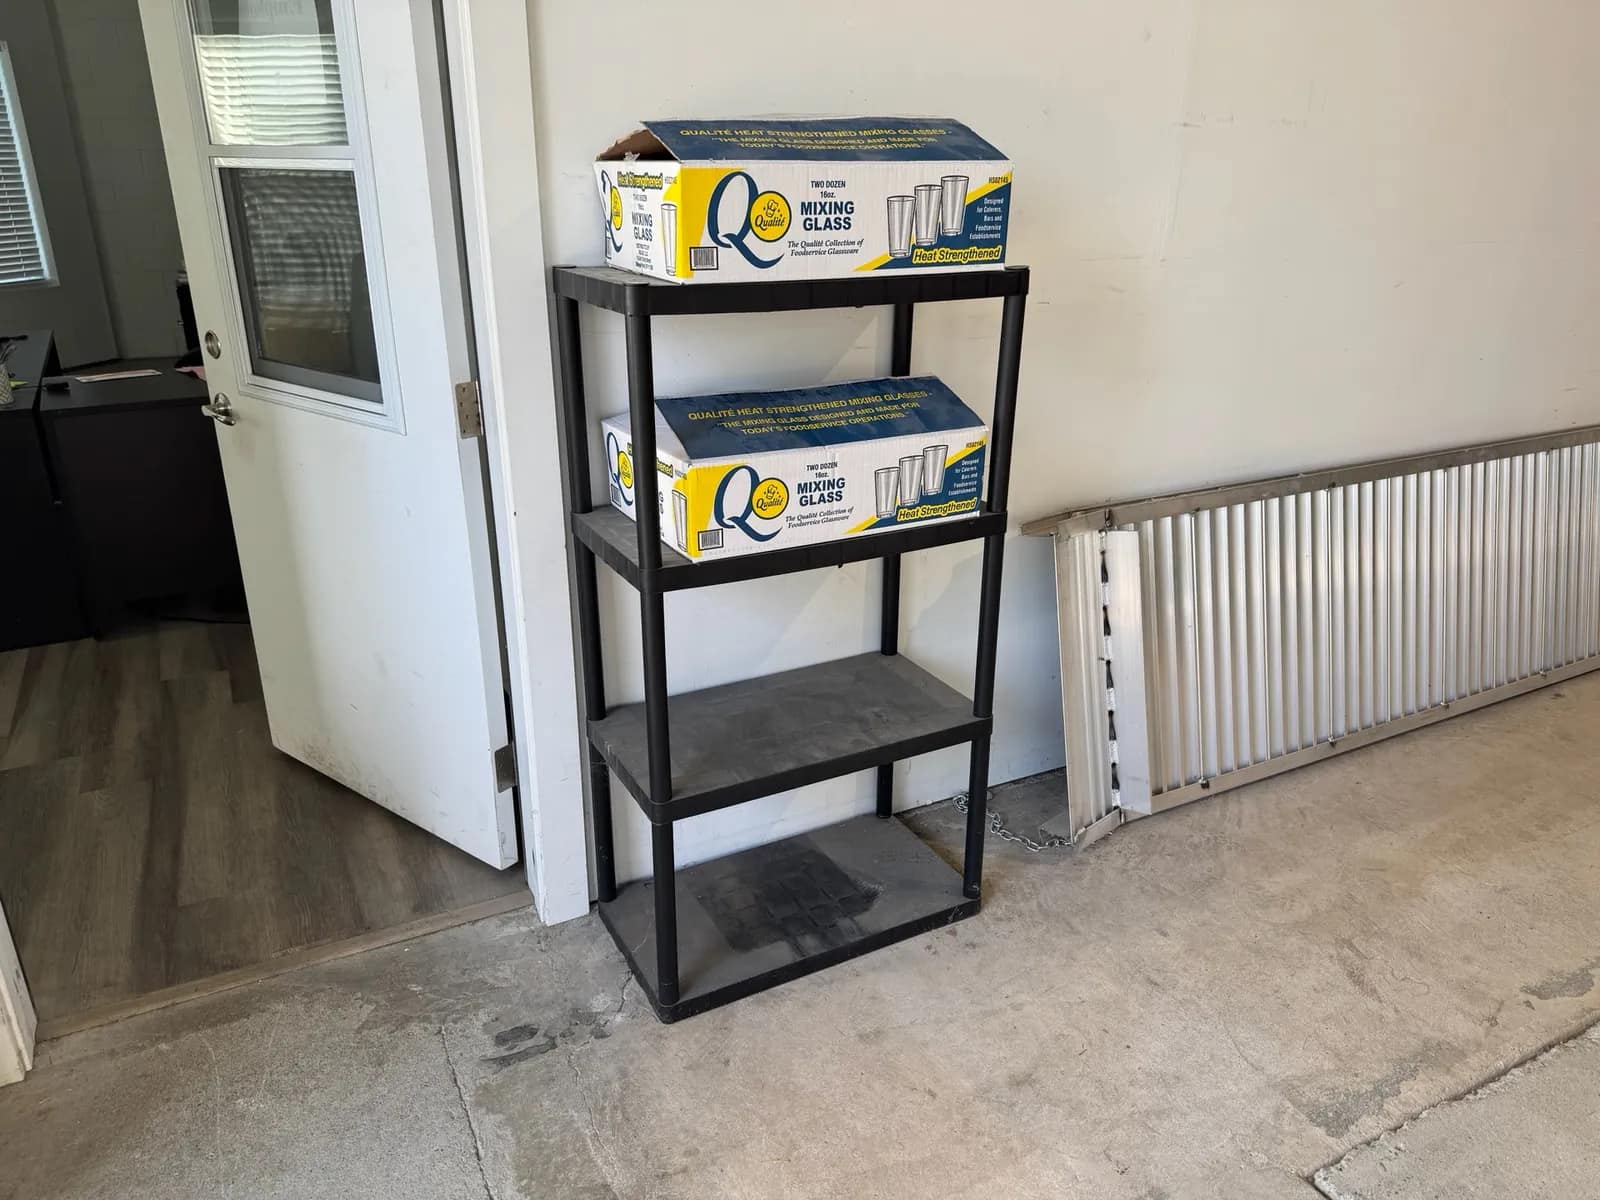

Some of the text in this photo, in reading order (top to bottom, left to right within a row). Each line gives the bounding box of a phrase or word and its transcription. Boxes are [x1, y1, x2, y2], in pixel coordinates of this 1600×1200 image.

[766, 130, 857, 138] STRENGTHENED
[810, 180, 846, 188] TWO DOZEN
[820, 190, 836, 198] 16oz.
[800, 201, 855, 215] MIXING
[983, 198, 1004, 206] Designed
[707, 171, 786, 269] Q Qualité
[803, 217, 852, 231] GLASS
[633, 227, 653, 242] GLASS
[969, 232, 1001, 240] Establishments
[788, 240, 799, 248] The
[824, 239, 856, 247] Collection
[856, 238, 865, 247] of
[790, 247, 860, 257] Foodservice Glassware
[913, 245, 1002, 263] Heat Strengthened
[688, 408, 736, 420] QUALITÉ
[736, 407, 764, 416] HEAT
[766, 399, 847, 415] STRENGTHENED
[848, 395, 883, 406] MIXING
[883, 390, 928, 401] GLASSES
[741, 417, 776, 426] MIXING
[776, 414, 808, 424] GLASS
[808, 409, 855, 421] DESIGNED
[856, 407, 875, 416] AND
[875, 403, 902, 413] MADE
[902, 400, 920, 409] FOR
[742, 425, 784, 436] TODAY'S
[806, 461, 838, 472] TWO DOZEN
[961, 458, 979, 466] Designed
[797, 478, 846, 494] MIXING
[713, 465, 783, 541] Q
[799, 491, 843, 507] GLASS
[786, 515, 796, 523] The
[818, 509, 847, 517] Collection
[847, 506, 855, 514] of
[898, 499, 977, 520] Heat Strengthened
[788, 515, 850, 529] Foodservice Glassware
